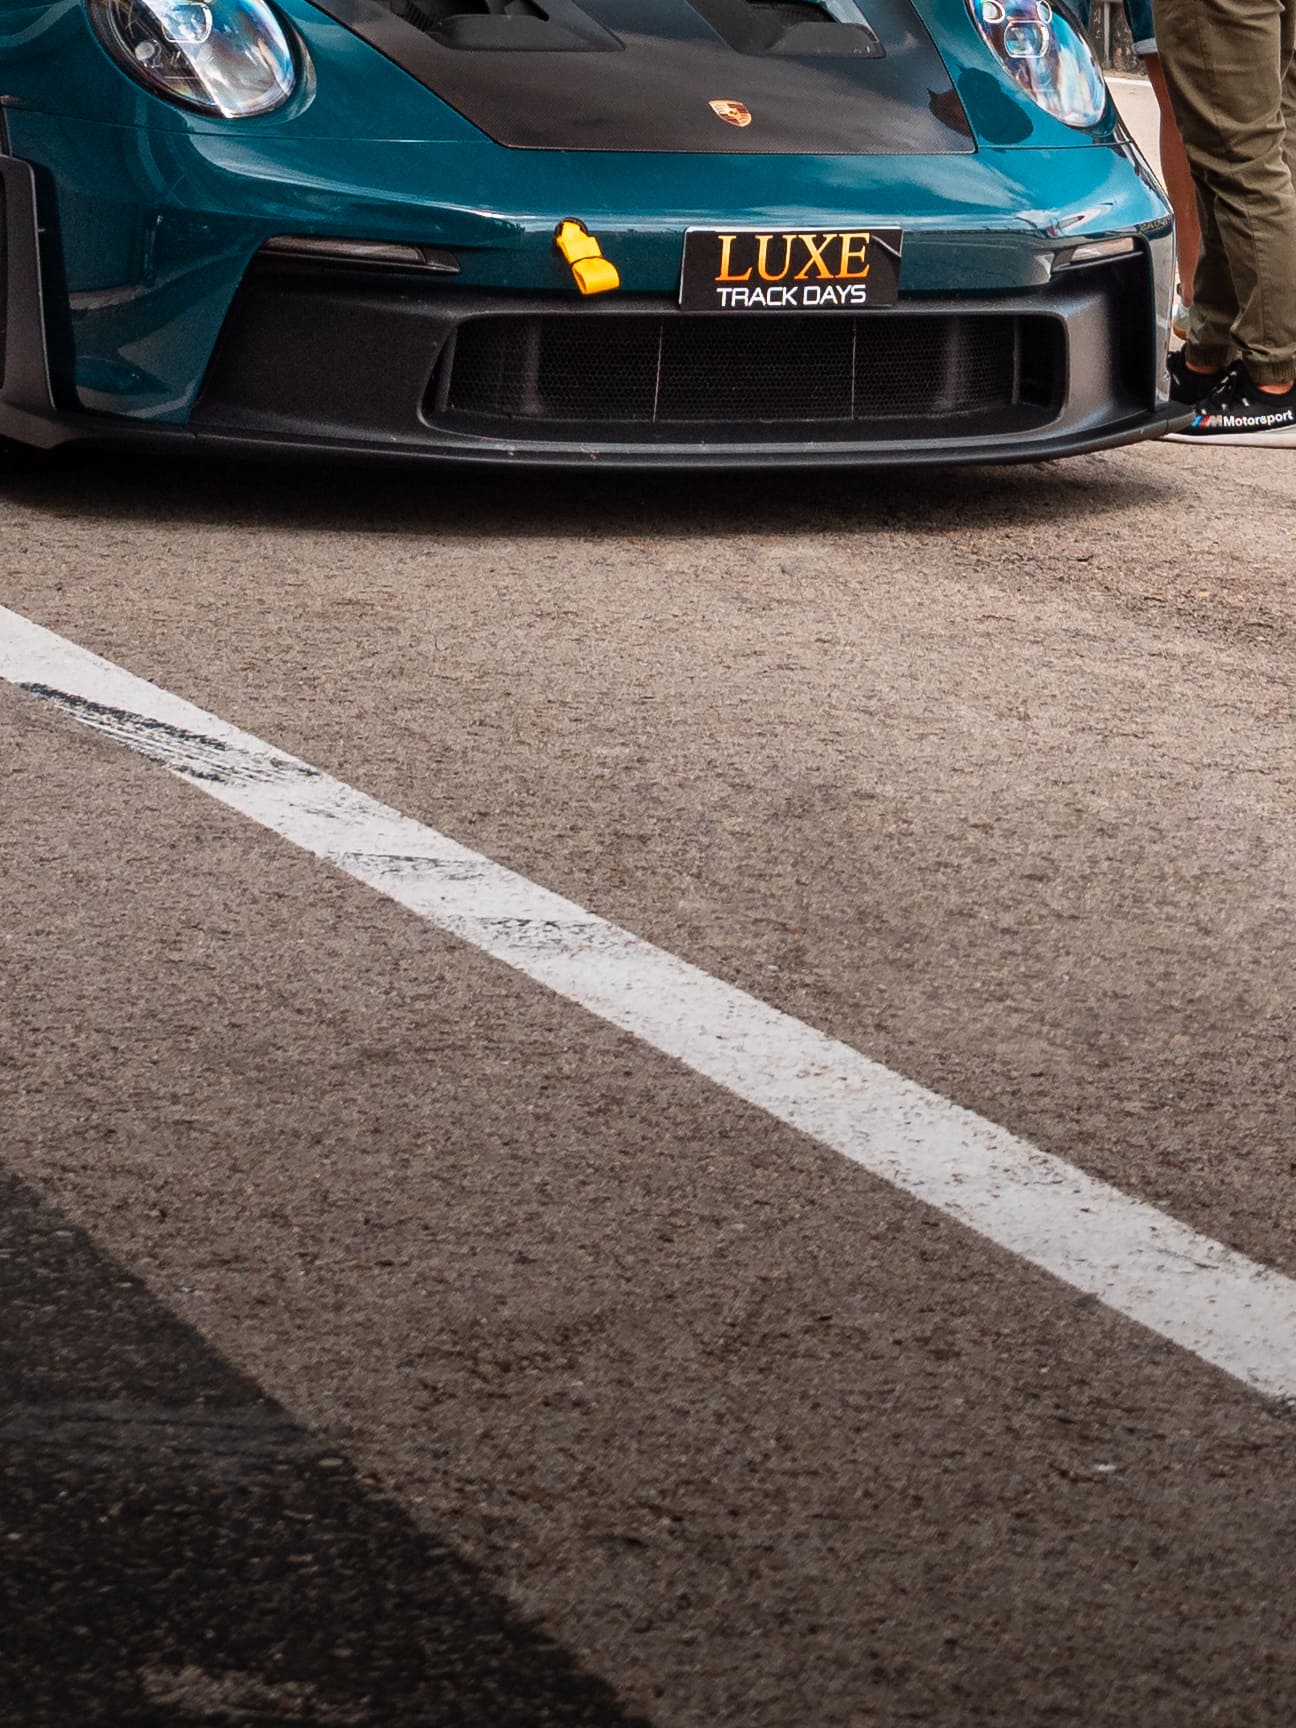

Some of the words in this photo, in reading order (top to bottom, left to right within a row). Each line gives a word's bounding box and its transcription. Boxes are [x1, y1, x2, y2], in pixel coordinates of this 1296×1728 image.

[714, 232, 870, 281] LUXE
[716, 286, 798, 308] TRACK
[803, 284, 867, 306] DAYS
[1223, 409, 1294, 427] Motorsport
